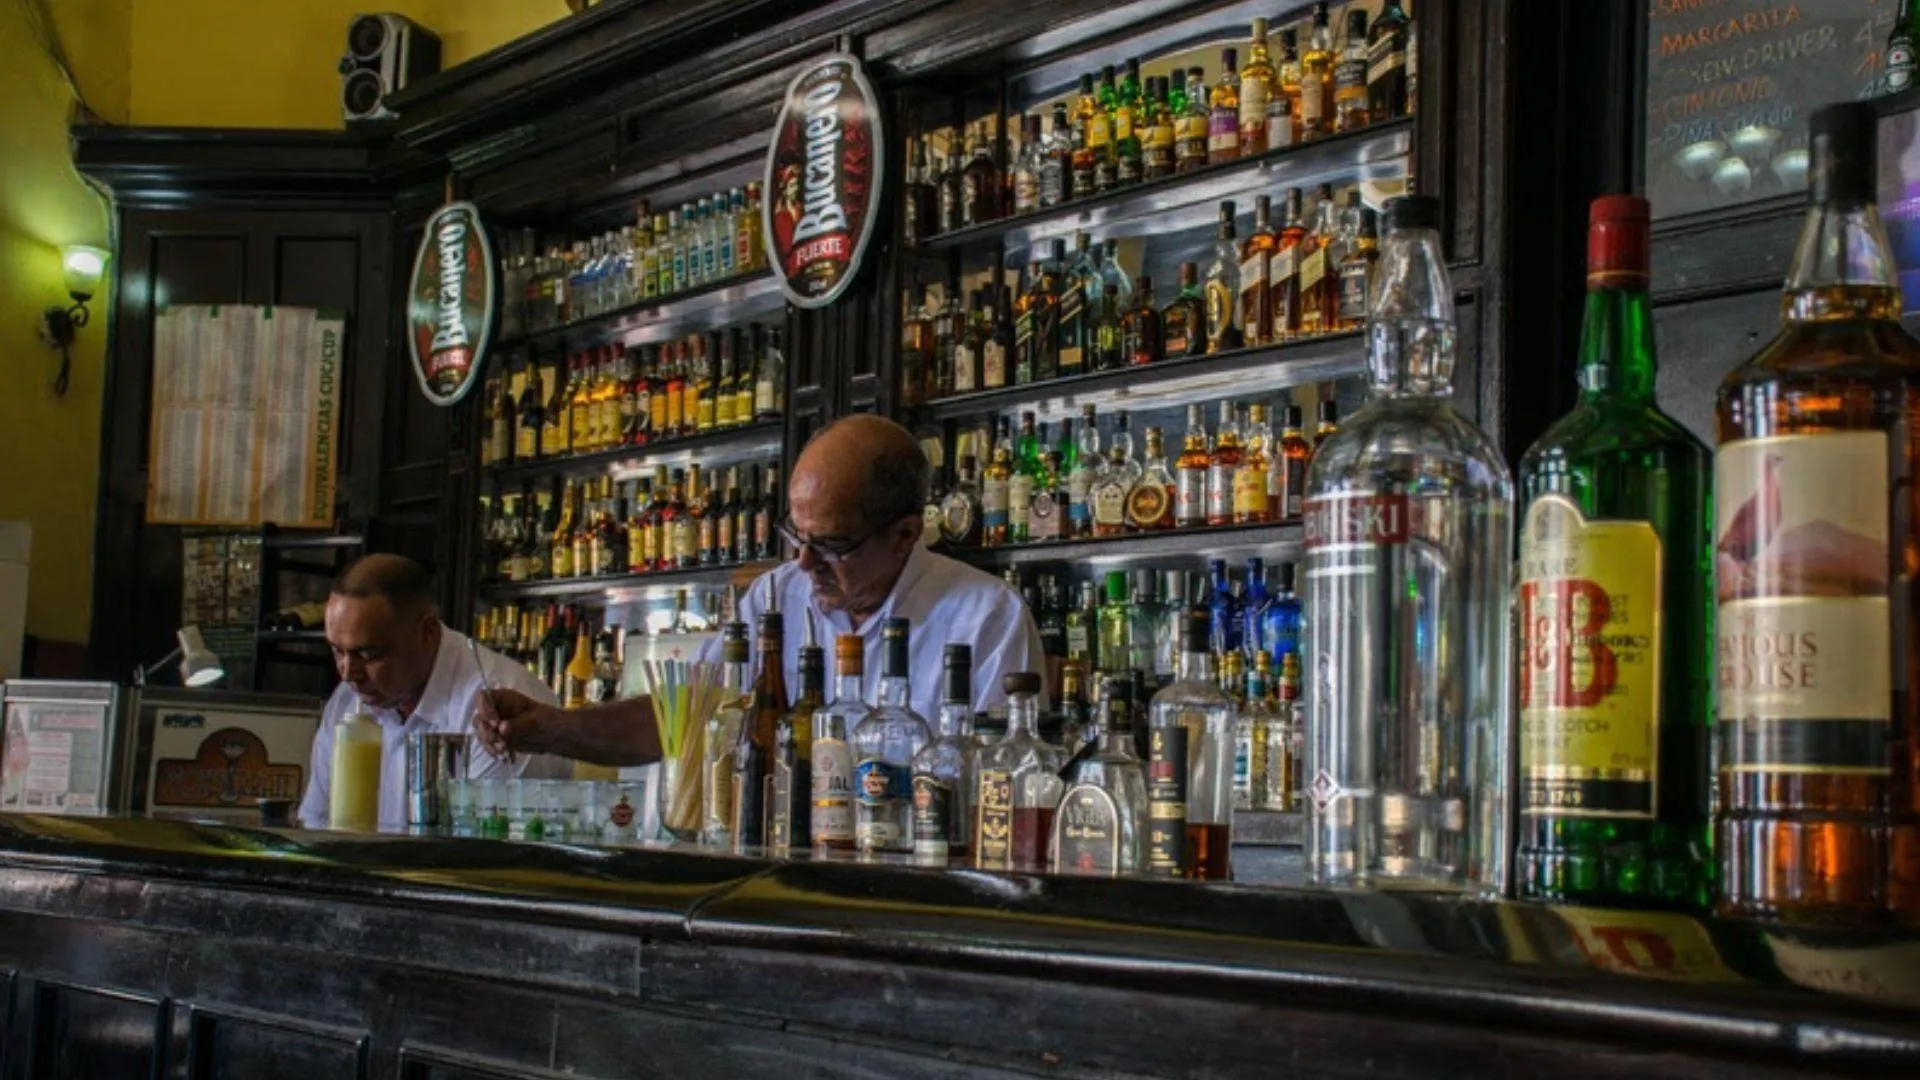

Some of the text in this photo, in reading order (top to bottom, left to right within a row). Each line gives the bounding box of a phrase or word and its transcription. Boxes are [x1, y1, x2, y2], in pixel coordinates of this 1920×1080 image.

[1661, 6, 1801, 54] MARGARITA
[1744, 26, 1836, 70] DRIVER
[796, 237, 843, 265] FUERTE
[314, 400, 333, 520] EQUIVALENCIAS
[1719, 631, 1818, 659] AMOUS
[1719, 662, 1816, 689] ROUSE
[1547, 718, 1610, 733] COTCH
